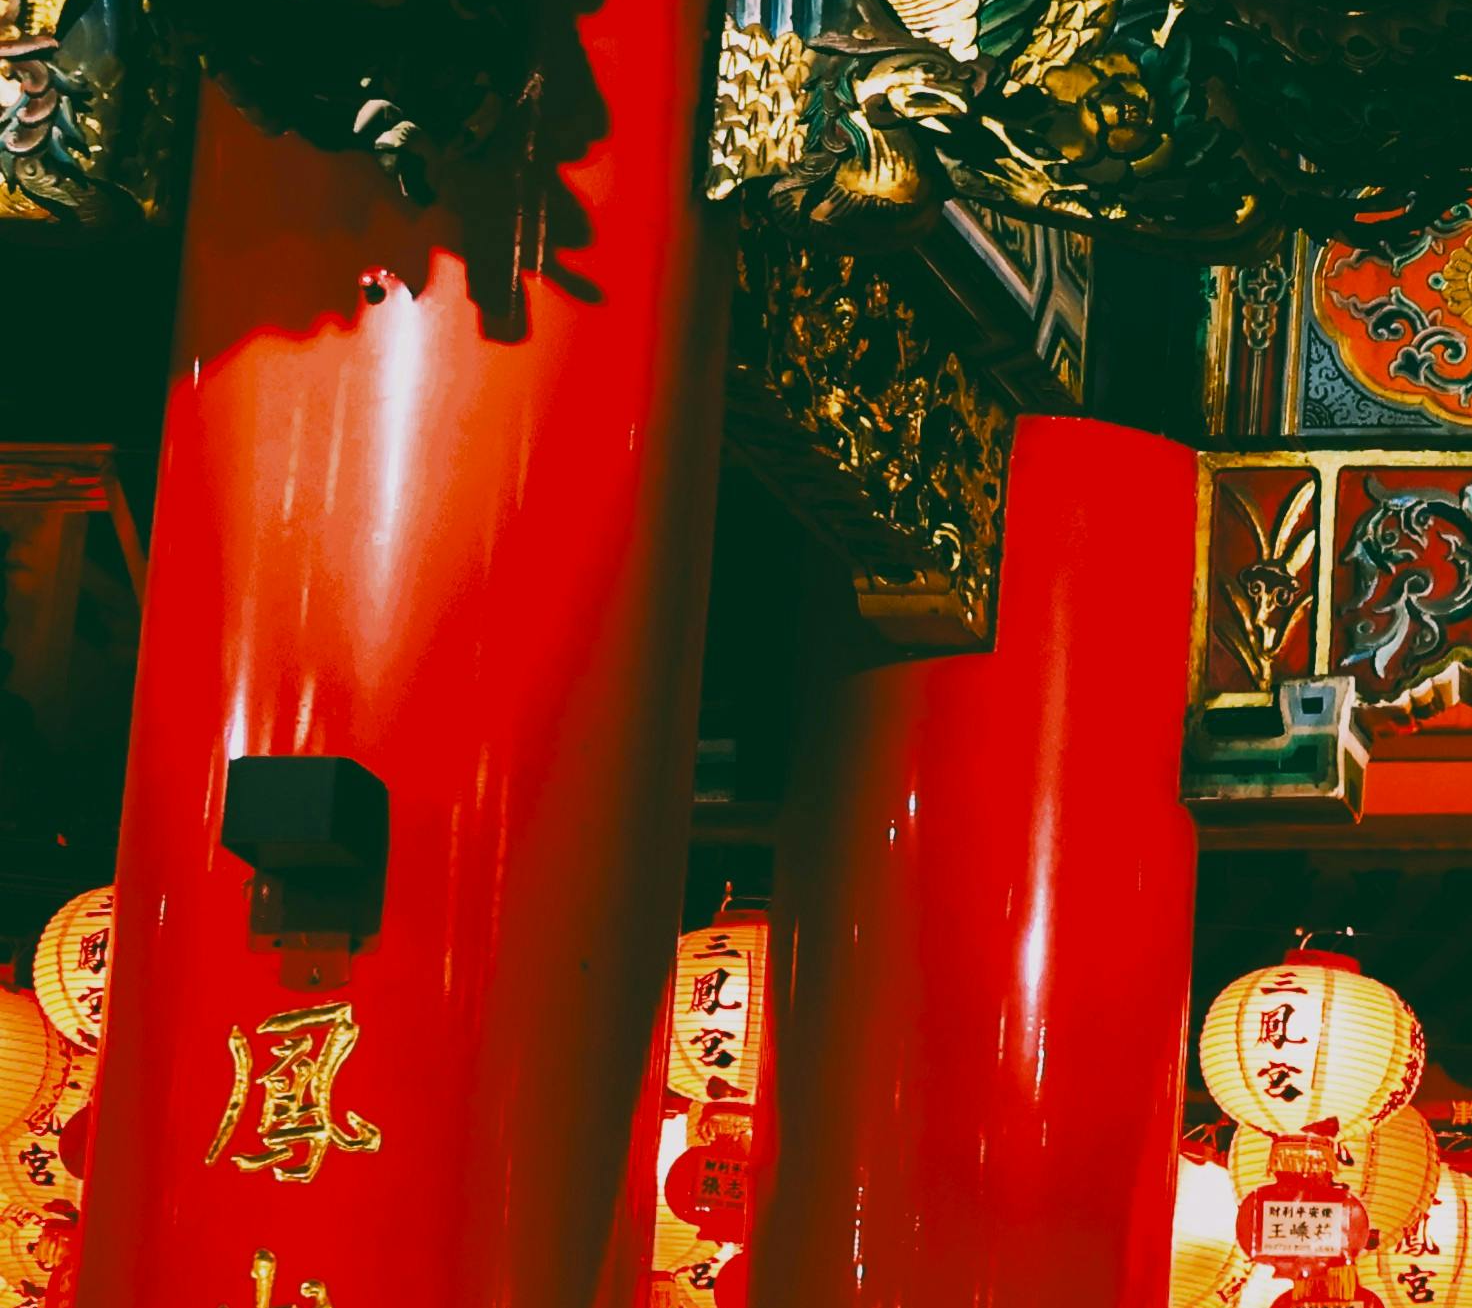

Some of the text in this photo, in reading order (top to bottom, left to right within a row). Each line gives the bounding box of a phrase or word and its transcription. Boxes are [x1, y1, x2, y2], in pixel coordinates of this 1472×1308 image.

[689, 935, 742, 1069] 三鳳宮
[1255, 972, 1308, 1102] 三鳳宮
[1395, 1197, 1440, 1304] 鳳宮
